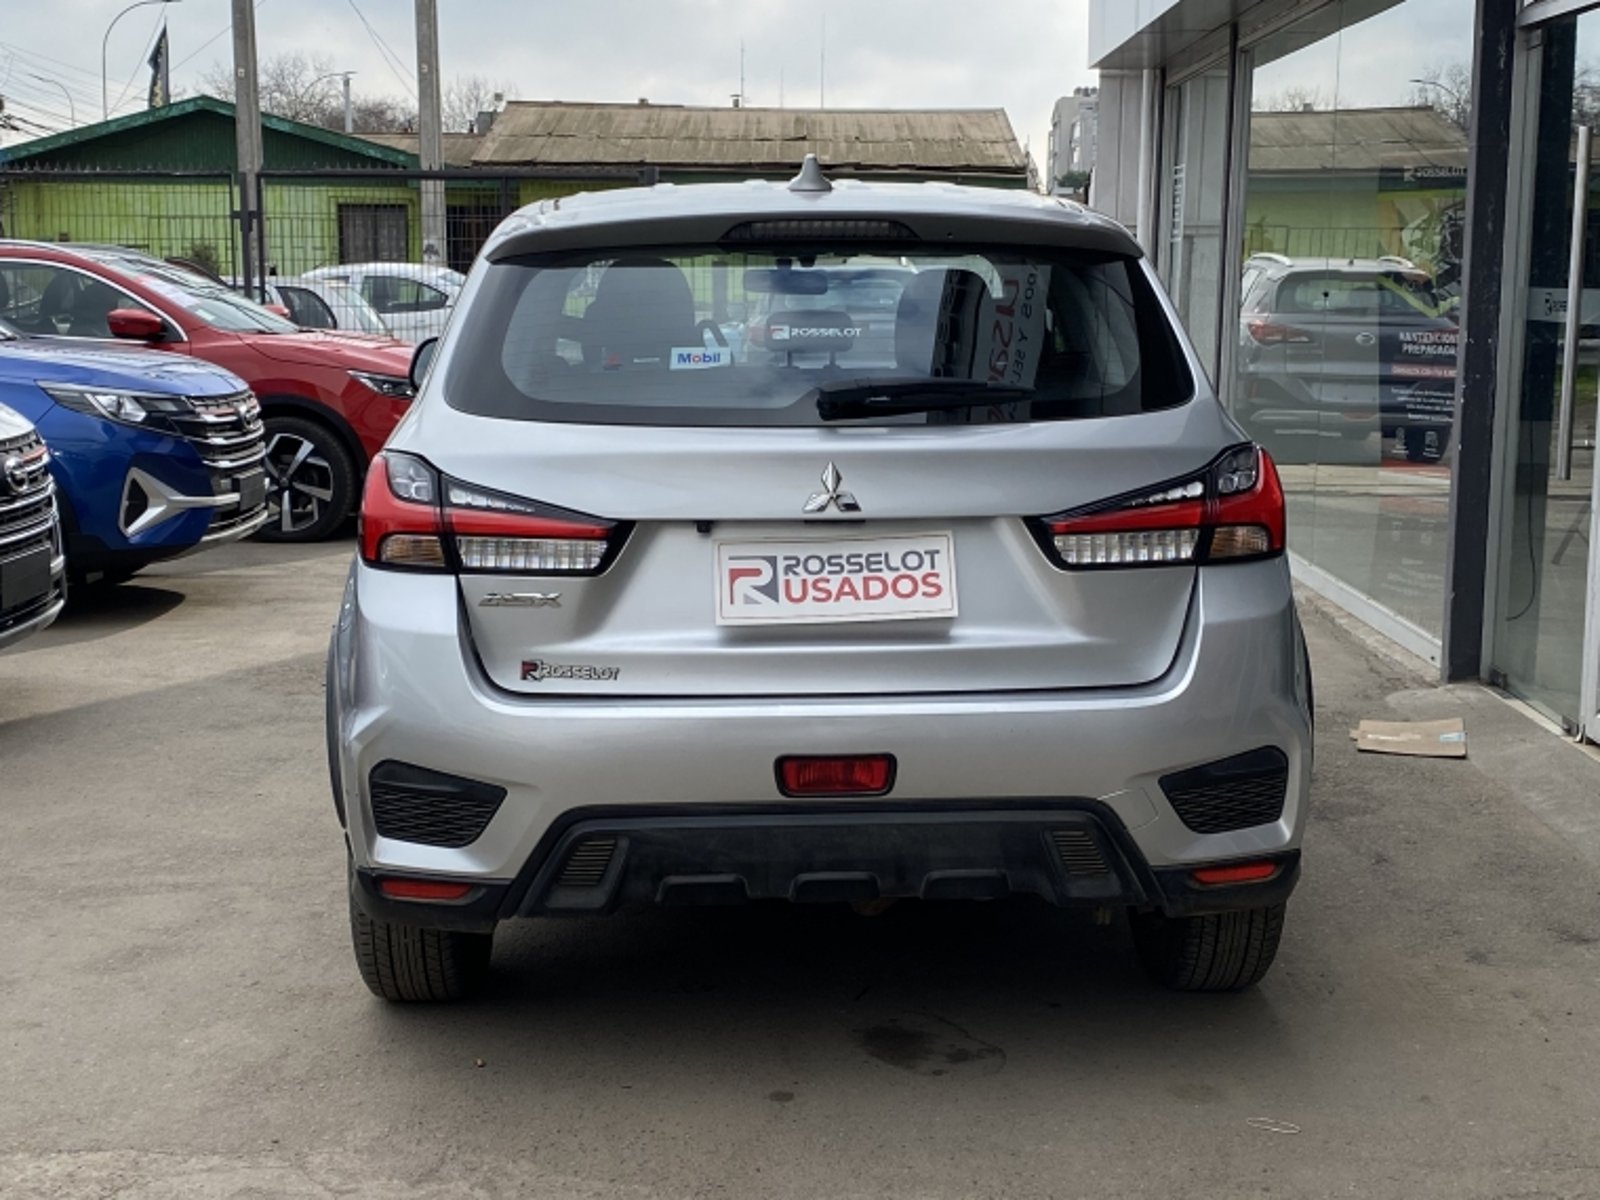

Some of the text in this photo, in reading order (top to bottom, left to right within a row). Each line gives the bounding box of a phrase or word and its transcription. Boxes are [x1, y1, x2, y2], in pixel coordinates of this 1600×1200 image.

[677, 352, 721, 364] Mobil
[783, 549, 941, 576] ROSSELOT
[784, 571, 943, 605] USADOS
[540, 662, 621, 681] ROSSELOT
